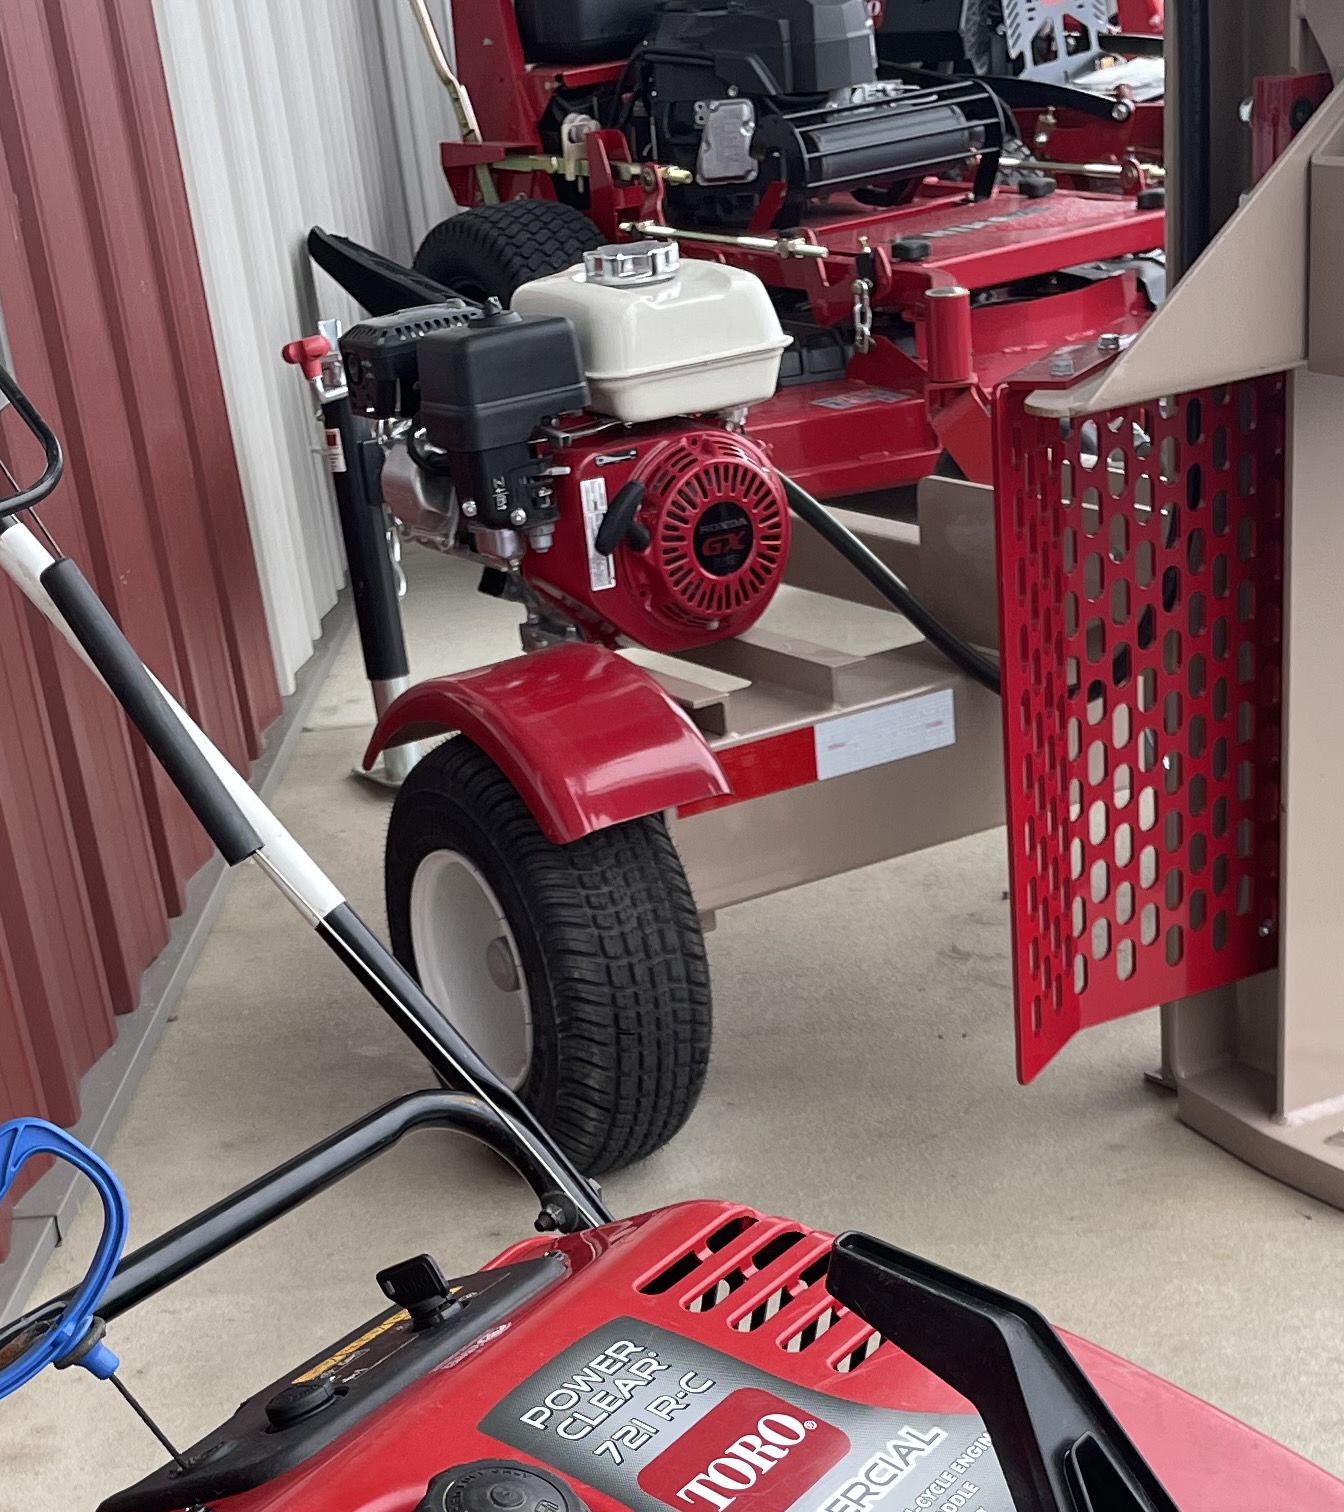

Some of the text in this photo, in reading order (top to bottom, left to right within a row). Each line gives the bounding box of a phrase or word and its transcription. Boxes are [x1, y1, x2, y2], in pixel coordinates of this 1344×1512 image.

[699, 517, 749, 535] HONDA
[701, 529, 747, 558] GX
[519, 1339, 647, 1431] POWER
[555, 1355, 672, 1442] CLEAR
[644, 1370, 717, 1422] R-C
[948, 1431, 992, 1475] ENGIN
